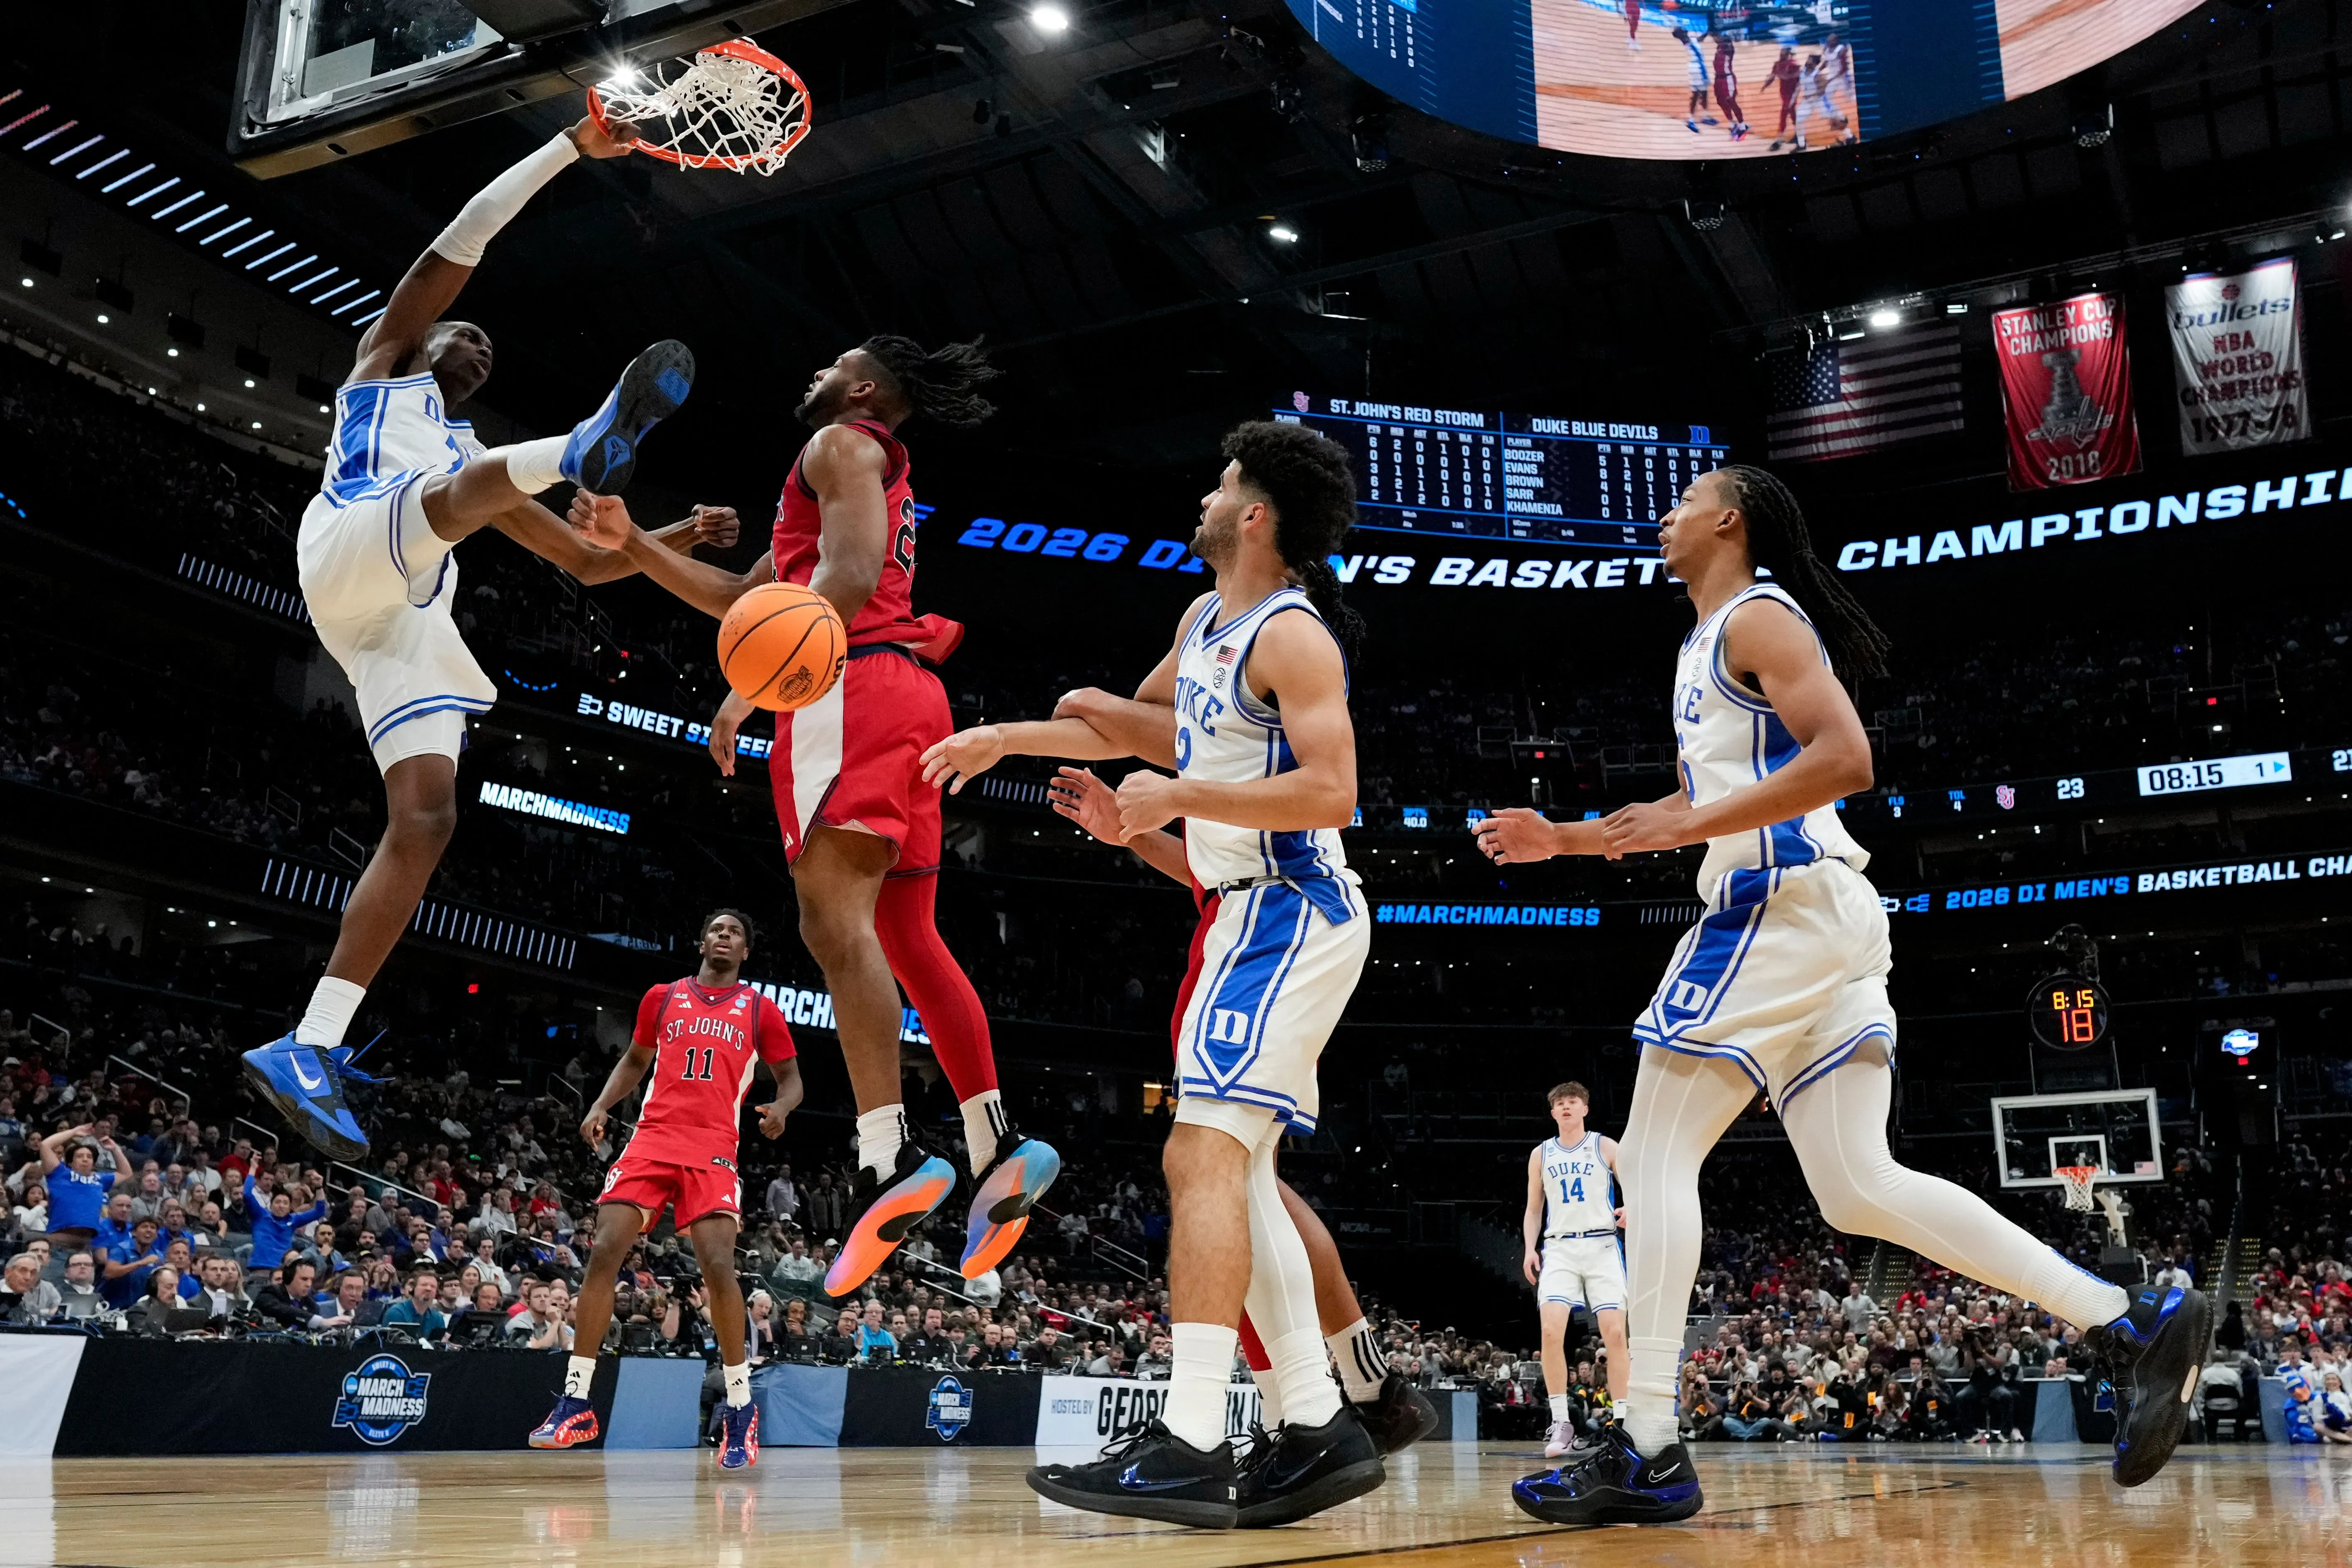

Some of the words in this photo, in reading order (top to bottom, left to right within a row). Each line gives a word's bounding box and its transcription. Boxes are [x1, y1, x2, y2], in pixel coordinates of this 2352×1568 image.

[2001, 305, 2076, 337] STANLEY
[2083, 299, 2117, 321] CUP
[2174, 298, 2290, 330] bullets
[2010, 319, 2113, 356] CHAMPIONS
[2214, 330, 2255, 354] NBA
[2200, 352, 2274, 380] WORLD
[1330, 399, 1351, 415] ST.
[1353, 402, 1402, 420] JOHN'S
[1404, 407, 1432, 423] RED
[1434, 410, 1484, 427] STORM
[1532, 418, 1569, 435] DUKE
[1572, 421, 1607, 437] BLUE
[1609, 424, 1658, 440] DEVILS
[1370, 437, 1377, 447] 6
[1394, 440, 1401, 449] 2
[1416, 442, 1424, 452] 0
[1441, 444, 1447, 454] 1
[1462, 446, 1470, 456] 0
[1482, 447, 1490, 457] 0
[1370, 450, 1377, 460] 0
[1394, 452, 1402, 463] 0
[1417, 454, 1424, 465] 0
[1440, 457, 1448, 467] 0
[1463, 459, 1470, 469] 1
[1483, 460, 1490, 471] 0
[1504, 449, 1544, 462] BOOZER
[1599, 456, 1606, 466] 5
[1623, 457, 1630, 467] 1
[1645, 458, 1653, 469] 0
[1669, 459, 1676, 470] 0
[1691, 461, 1698, 471] 0
[1712, 462, 1717, 471] 1
[2046, 450, 2101, 481] 2018
[1370, 463, 1378, 473] 3
[1395, 465, 1402, 476] 1
[1418, 467, 1424, 478] 1
[1441, 469, 1449, 480] 0
[1463, 472, 1471, 482] 0
[1483, 473, 1491, 484] 0
[1505, 462, 1538, 474] EVANS
[1600, 469, 1607, 479] 8
[1624, 470, 1631, 480] 2
[1646, 471, 1654, 482] 0
[1670, 472, 1677, 483] 0
[1371, 476, 1378, 486] 6
[1395, 478, 1402, 489] 2
[1418, 480, 1425, 491] 1
[1442, 482, 1449, 493] 1
[1464, 484, 1471, 495] 0
[1485, 486, 1491, 496] 1
[1506, 474, 1544, 488] BROWN
[1601, 482, 1608, 492] 4
[1624, 483, 1632, 493] 4
[1647, 484, 1654, 494] 1
[1671, 485, 1678, 496] 1
[1371, 489, 1379, 500] 2
[1396, 491, 1402, 502] 1
[1418, 494, 1425, 504] 2
[1442, 496, 1449, 506] 0
[1464, 497, 1472, 508] 0
[1484, 499, 1492, 510] 0
[1506, 488, 1534, 500] SARR
[1601, 494, 1609, 505] 0
[1626, 496, 1632, 506] 1
[1648, 497, 1655, 507] 1
[1671, 498, 1678, 508] 0
[1507, 501, 1563, 515] KHAMENIA
[1602, 507, 1609, 518] 0
[1626, 509, 1633, 519] 1
[1649, 510, 1656, 520] 0
[958, 517, 1130, 562] 2026
[1327, 555, 1415, 584] N'S
[607, 701, 684, 738] SWEET
[2057, 778, 2084, 800] 23
[2149, 763, 2223, 791] 08:15
[2256, 762, 2264, 777] 1
[1949, 790, 1965, 801] TOL
[1954, 801, 1962, 811] 4
[479, 781, 630, 835] MARCHMADNESS
[1894, 806, 1901, 817] 3
[1404, 817, 1427, 827] 40.0
[1946, 887, 2010, 909] 2026
[2018, 883, 2046, 903] DI
[2055, 876, 2130, 900] MEN'S
[2138, 860, 2300, 893] BASKETBALL
[1377, 901, 1600, 926] #MARCHMADNESS
[1668, 979, 1708, 1011] D
[2053, 990, 2094, 1010] 8:15
[666, 1019, 684, 1042] ST.
[689, 1017, 745, 1051] JOHN'S
[1209, 1008, 1249, 1045] D
[2062, 1009, 2093, 1042] 18
[681, 1047, 714, 1081] 11
[1548, 1162, 1594, 1179] DUKE
[1560, 1177, 1584, 1203] 14
[357, 1378, 405, 1397] MARCH
[361, 1398, 424, 1416] MADNESS
[1051, 1399, 1081, 1414] HOSTED
[1083, 1400, 1094, 1414] BY
